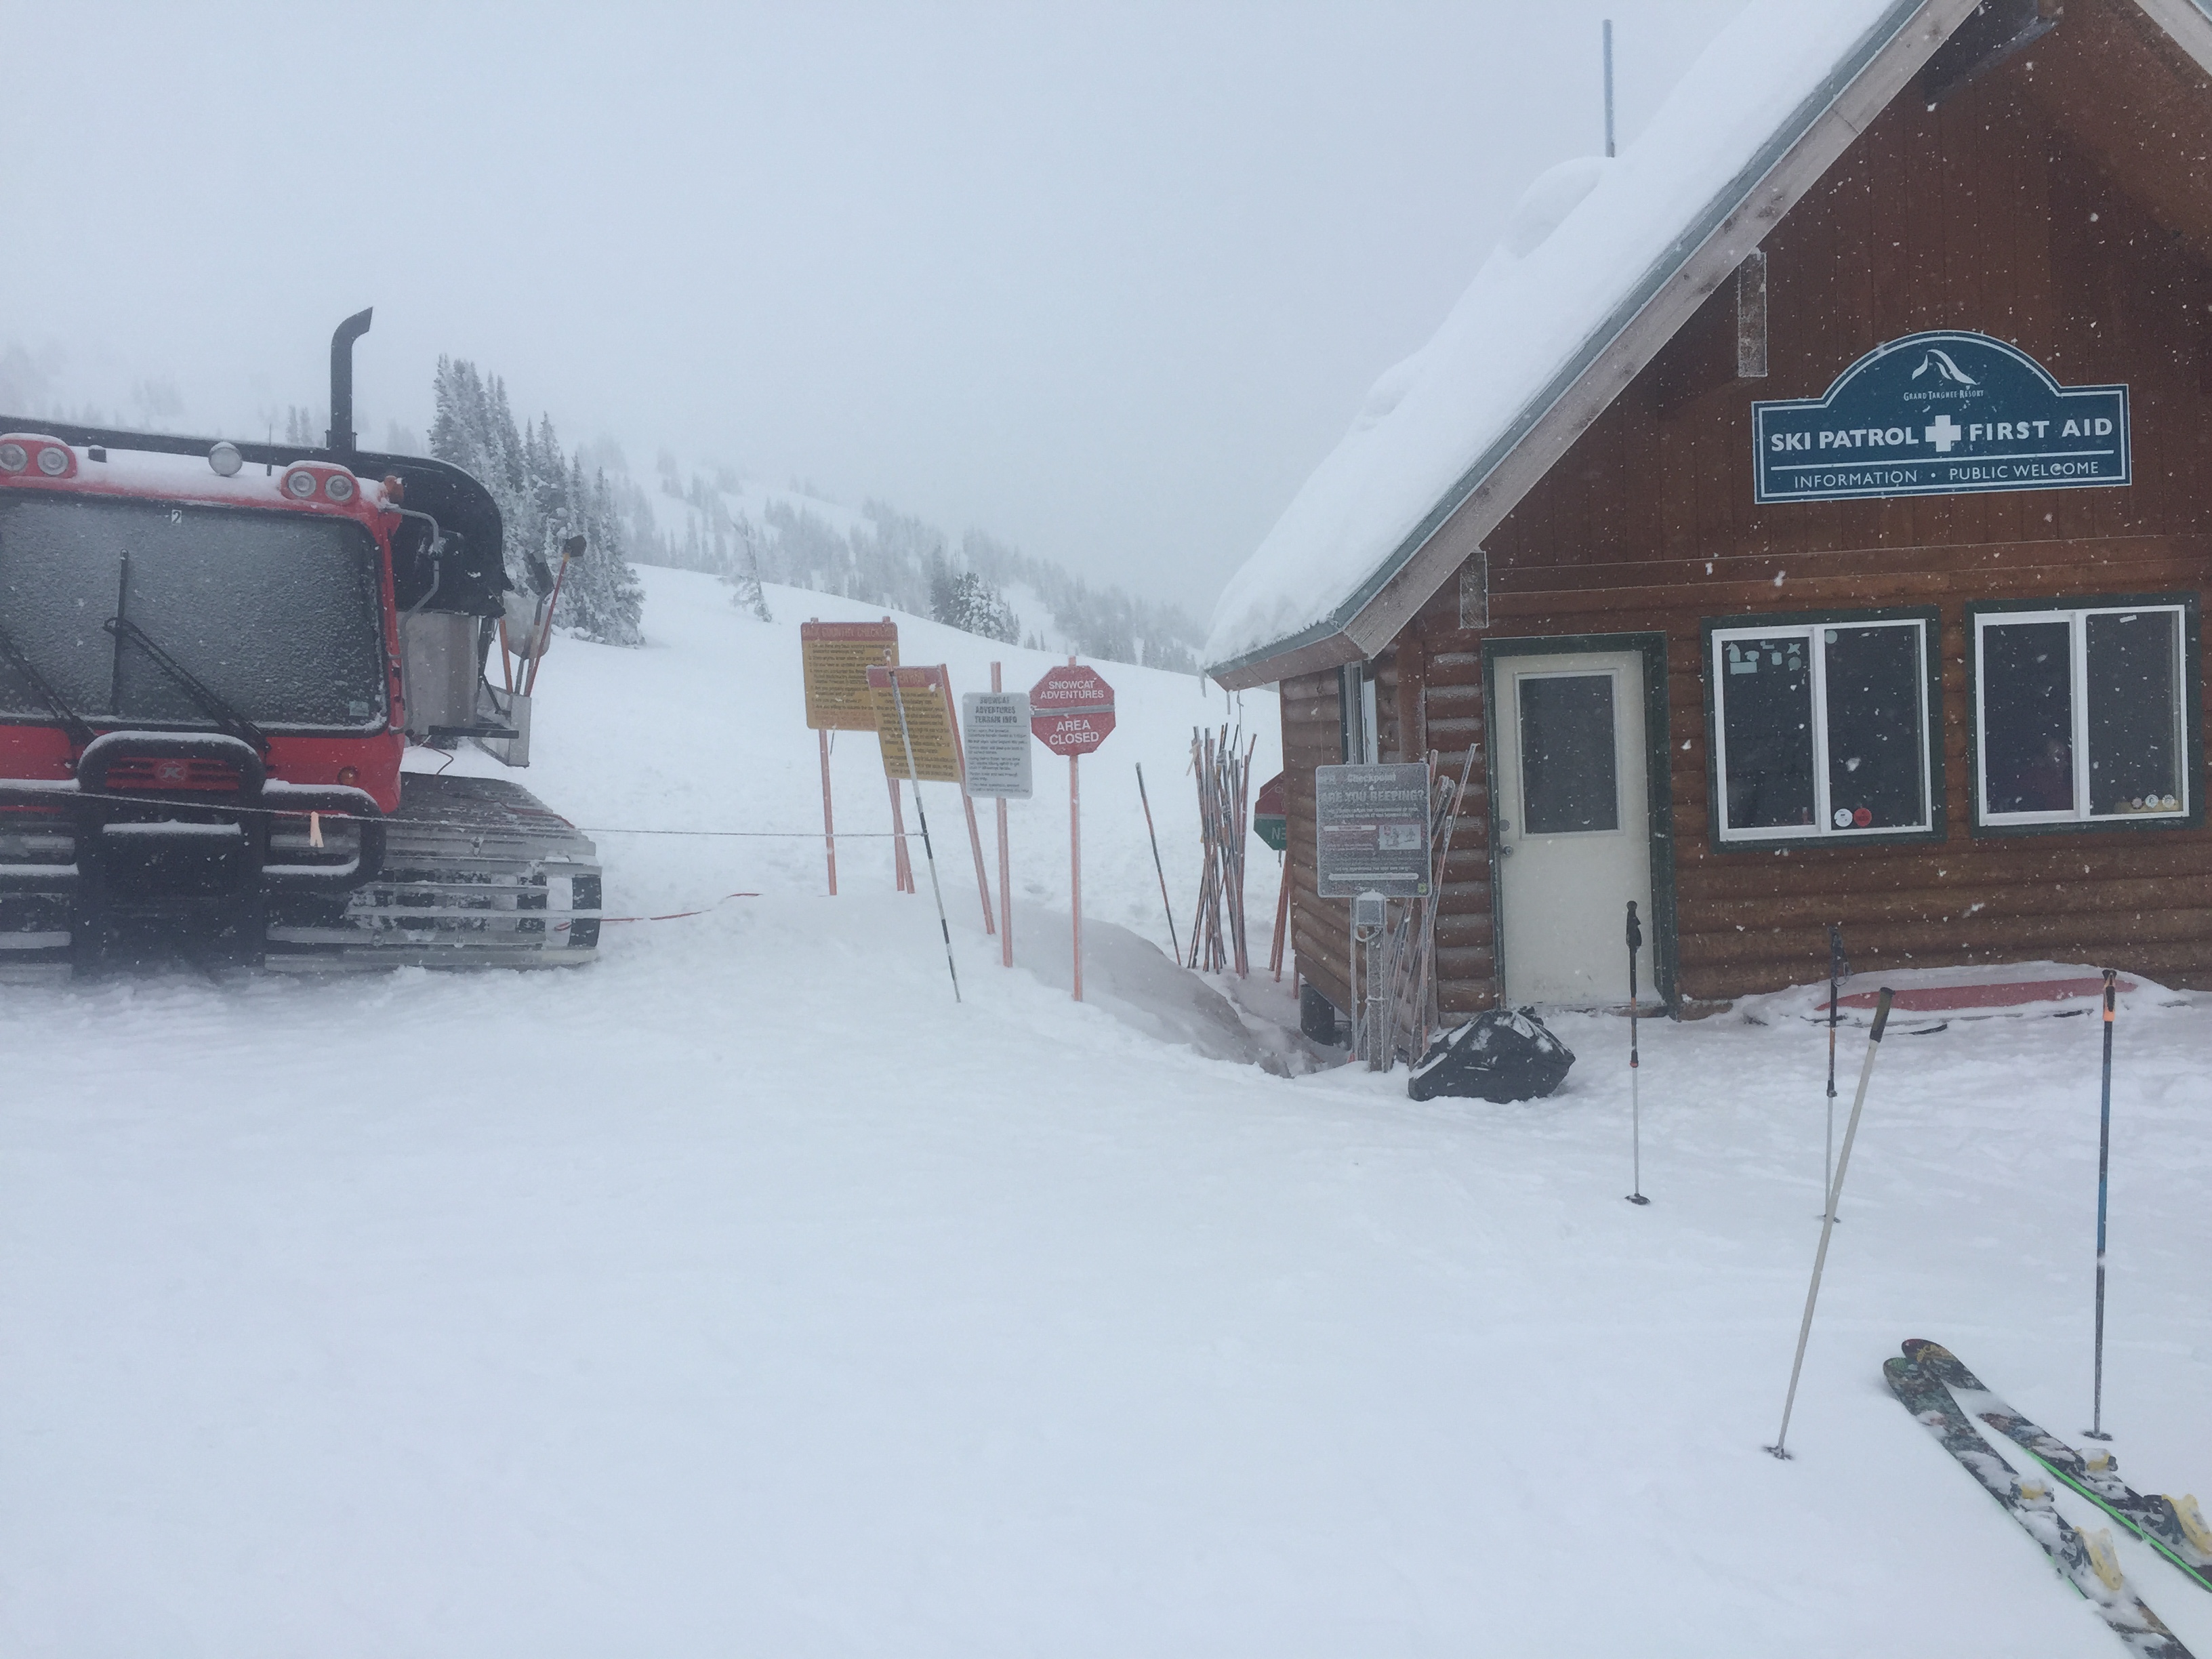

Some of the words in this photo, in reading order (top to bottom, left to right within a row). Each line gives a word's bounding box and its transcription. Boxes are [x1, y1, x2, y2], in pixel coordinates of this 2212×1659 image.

[1903, 392, 1927, 401] GRAND
[1928, 390, 1958, 400] TARGHEE
[1959, 390, 1984, 398] RESORT
[1771, 432, 1811, 451] SKI
[1819, 427, 1919, 449] PATROL
[1969, 420, 2050, 441] FIRST
[2061, 418, 2113, 437] AID
[1795, 470, 1917, 489] INFORMATION
[1949, 466, 2008, 480] PUBLIC
[2013, 462, 2100, 477] WELCOME
[1048, 680, 1095, 690] SNOWCAT
[1040, 690, 1104, 699] ADVENTURES
[1057, 720, 1091, 732] AREA
[1049, 732, 1099, 745] CLOSED
[1345, 791, 1367, 802] YOU
